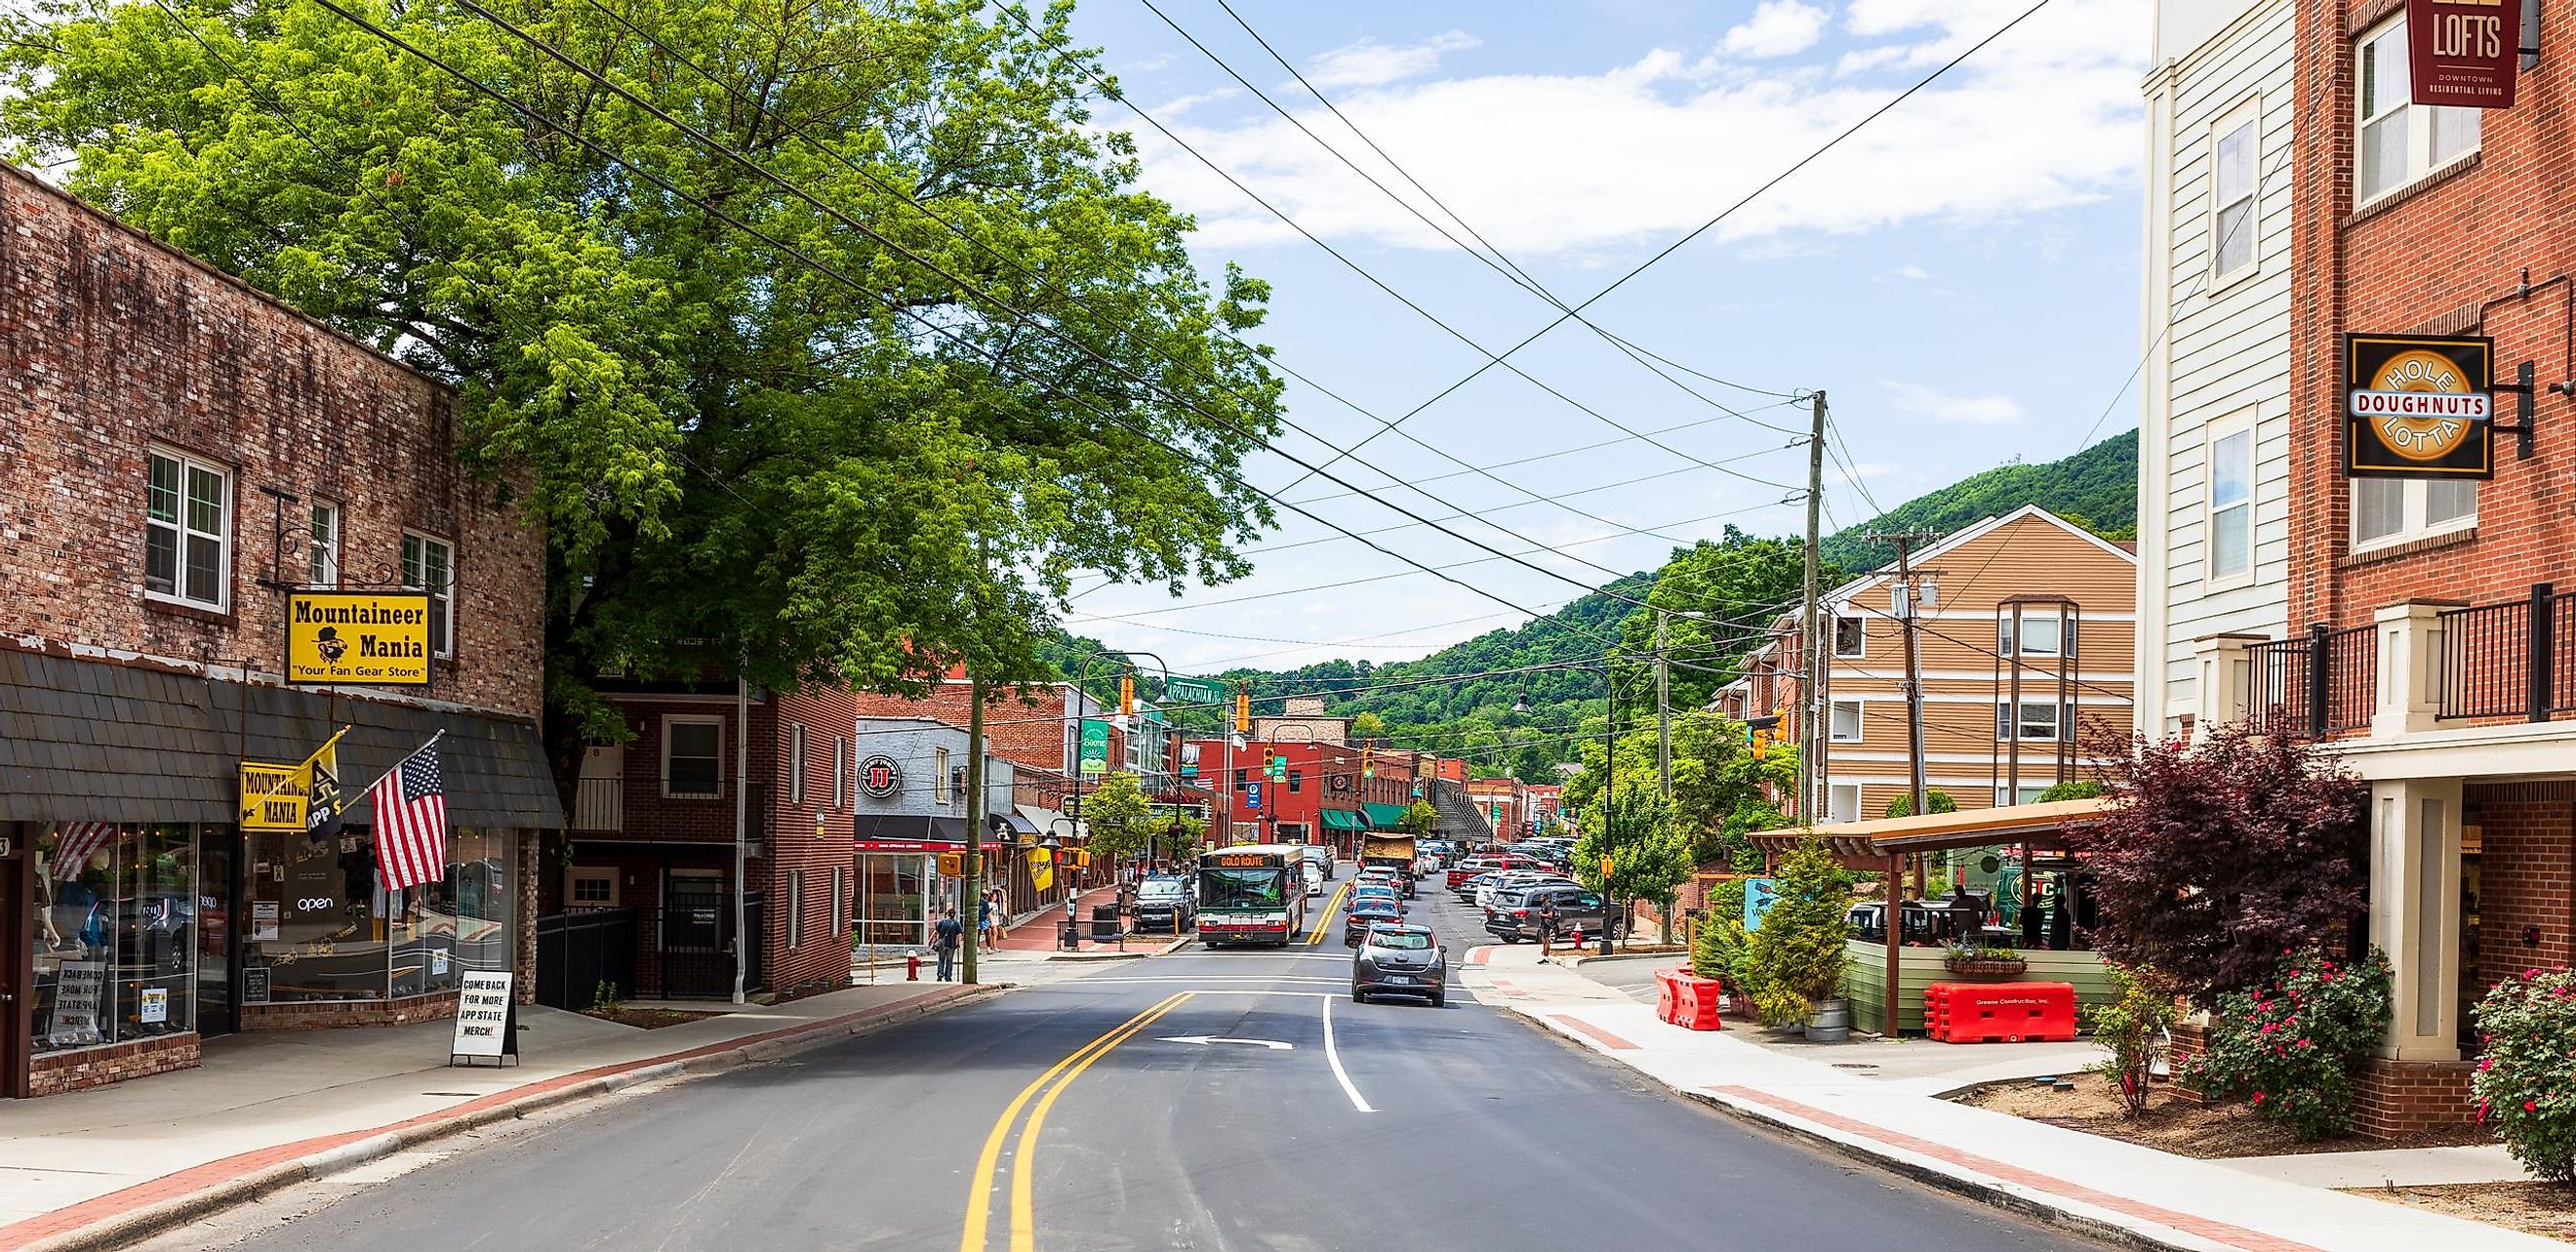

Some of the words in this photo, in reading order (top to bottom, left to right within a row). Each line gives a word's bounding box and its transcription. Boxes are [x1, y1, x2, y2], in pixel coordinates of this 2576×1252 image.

[2433, 14, 2500, 58] LOFTS
[2438, 74, 2493, 83] DOWNTOWN
[2429, 84, 2475, 95] RESIDENTIAL
[2477, 86, 2502, 96] LIVING
[2385, 359, 2457, 392] HOLE
[2358, 394, 2483, 415] DOUGHNUTS
[2383, 417, 2461, 452] LOTTA
[295, 600, 423, 625] Mountaineer
[360, 634, 423, 658] Mania
[330, 666, 351, 676] Fan
[355, 666, 383, 677] Gear
[1167, 684, 1213, 704] APPALACHIAN
[870, 768, 889, 788] JJ
[263, 801, 297, 823] MANIA
[307, 806, 331, 831] APP
[298, 898, 333, 912] open
[464, 994, 480, 1004] FOR
[481, 995, 503, 1006] MORE
[460, 1010, 477, 1021] APP
[477, 1011, 503, 1022] STATE
[463, 1026, 494, 1036] MERCH!
